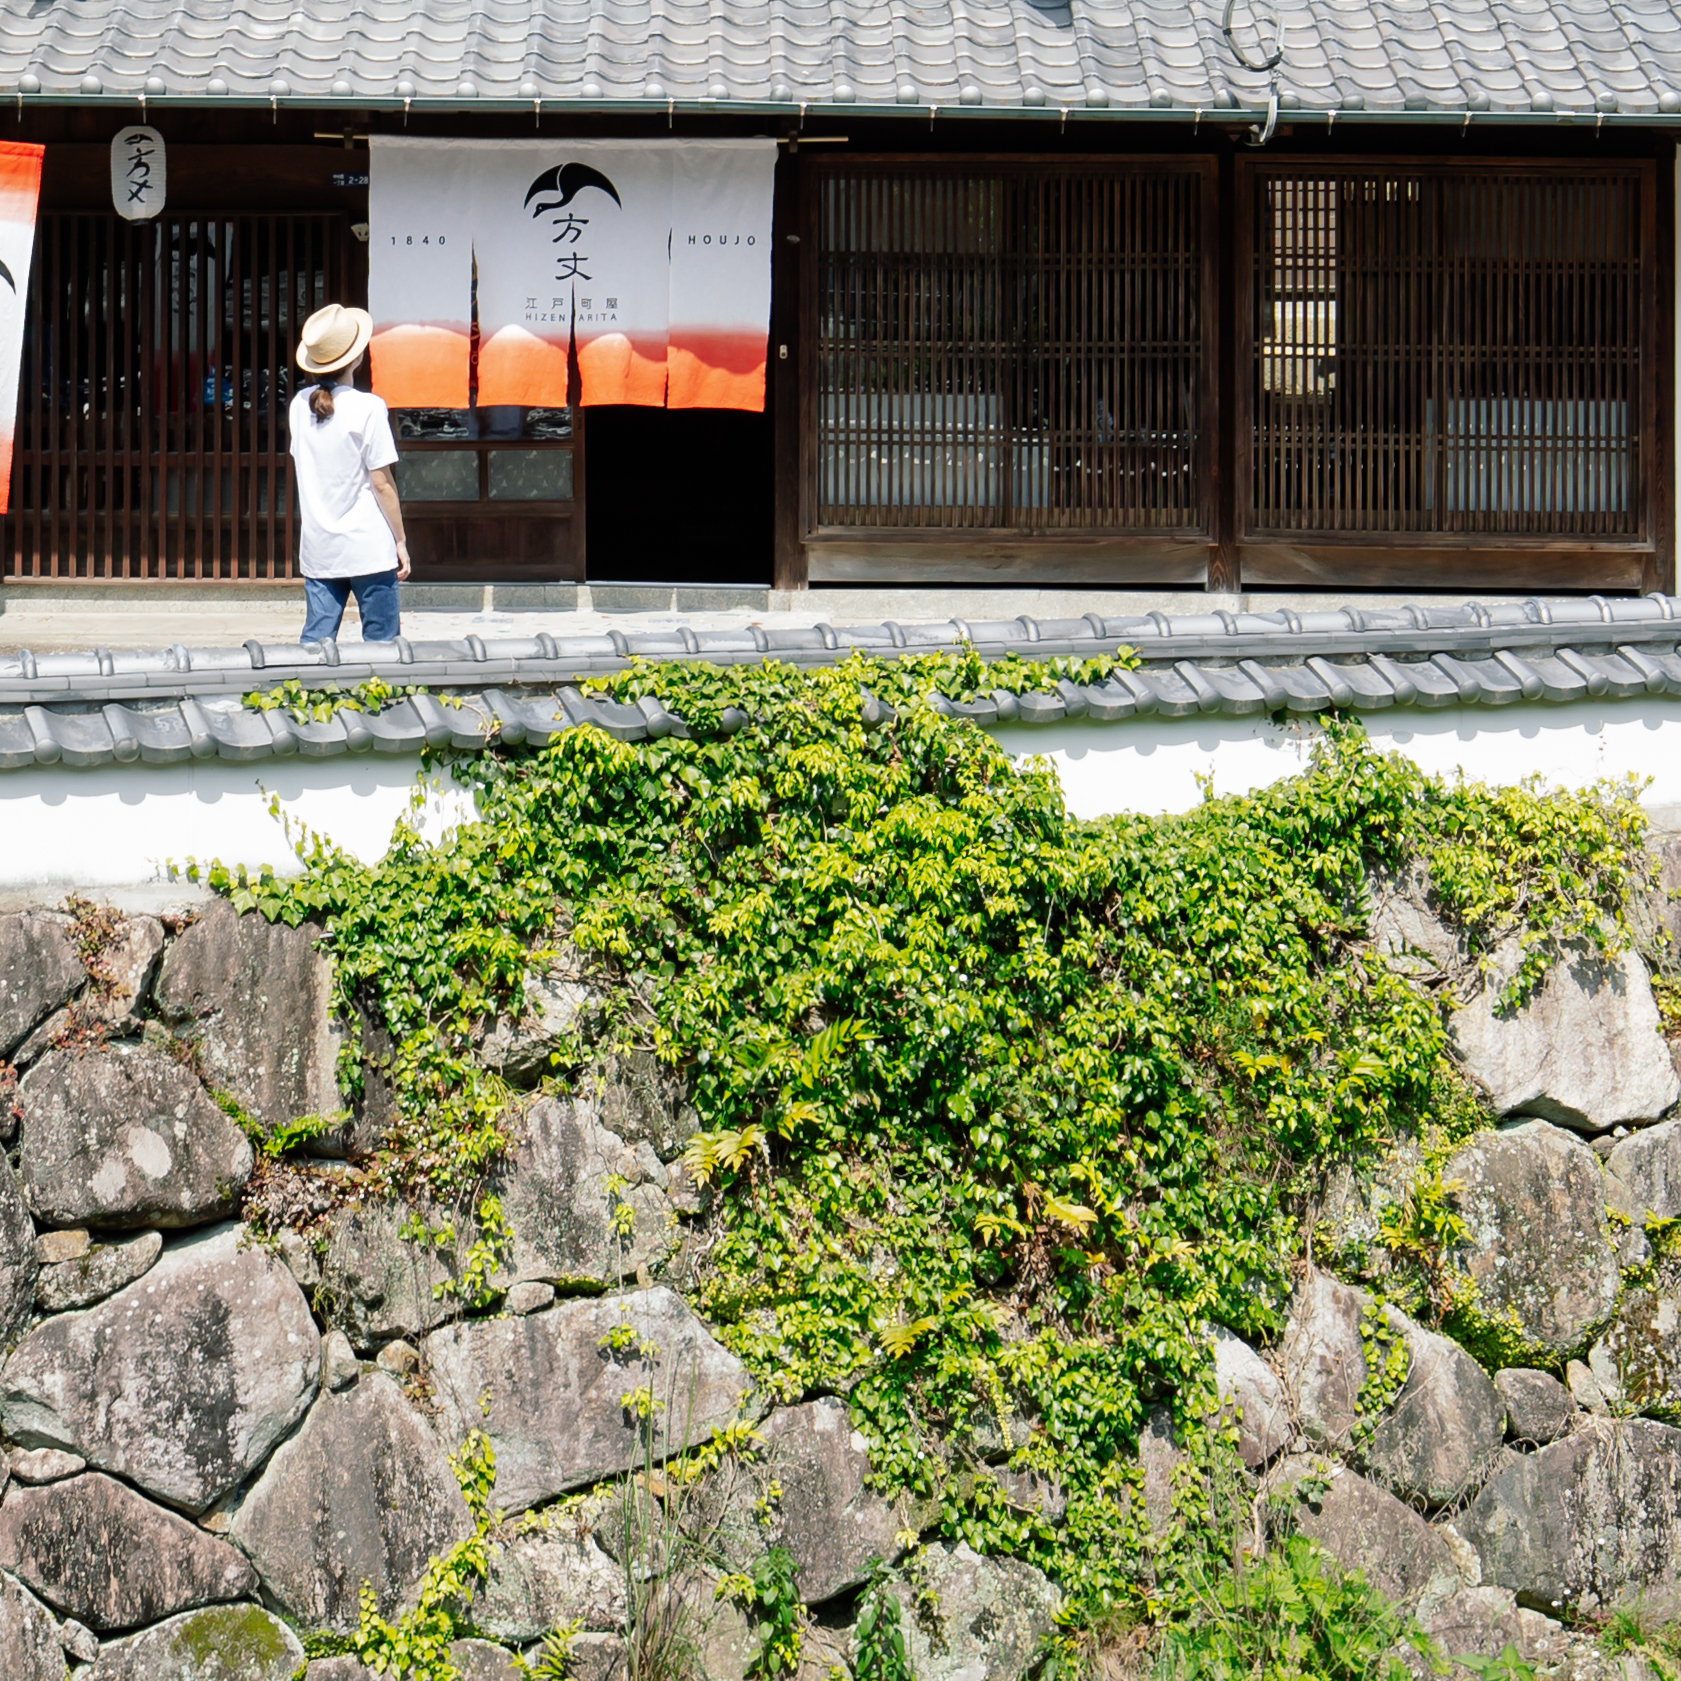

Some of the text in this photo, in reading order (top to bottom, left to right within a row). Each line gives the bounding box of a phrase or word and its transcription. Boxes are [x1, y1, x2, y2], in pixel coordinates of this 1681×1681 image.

[126, 147, 156, 203] 方丈
[391, 235, 446, 246] 1840
[688, 234, 756, 246] HOUJO
[552, 212, 593, 281] 方丈
[524, 297, 619, 310] 江戸町屋
[525, 313, 618, 322] HIZEN ARITA
